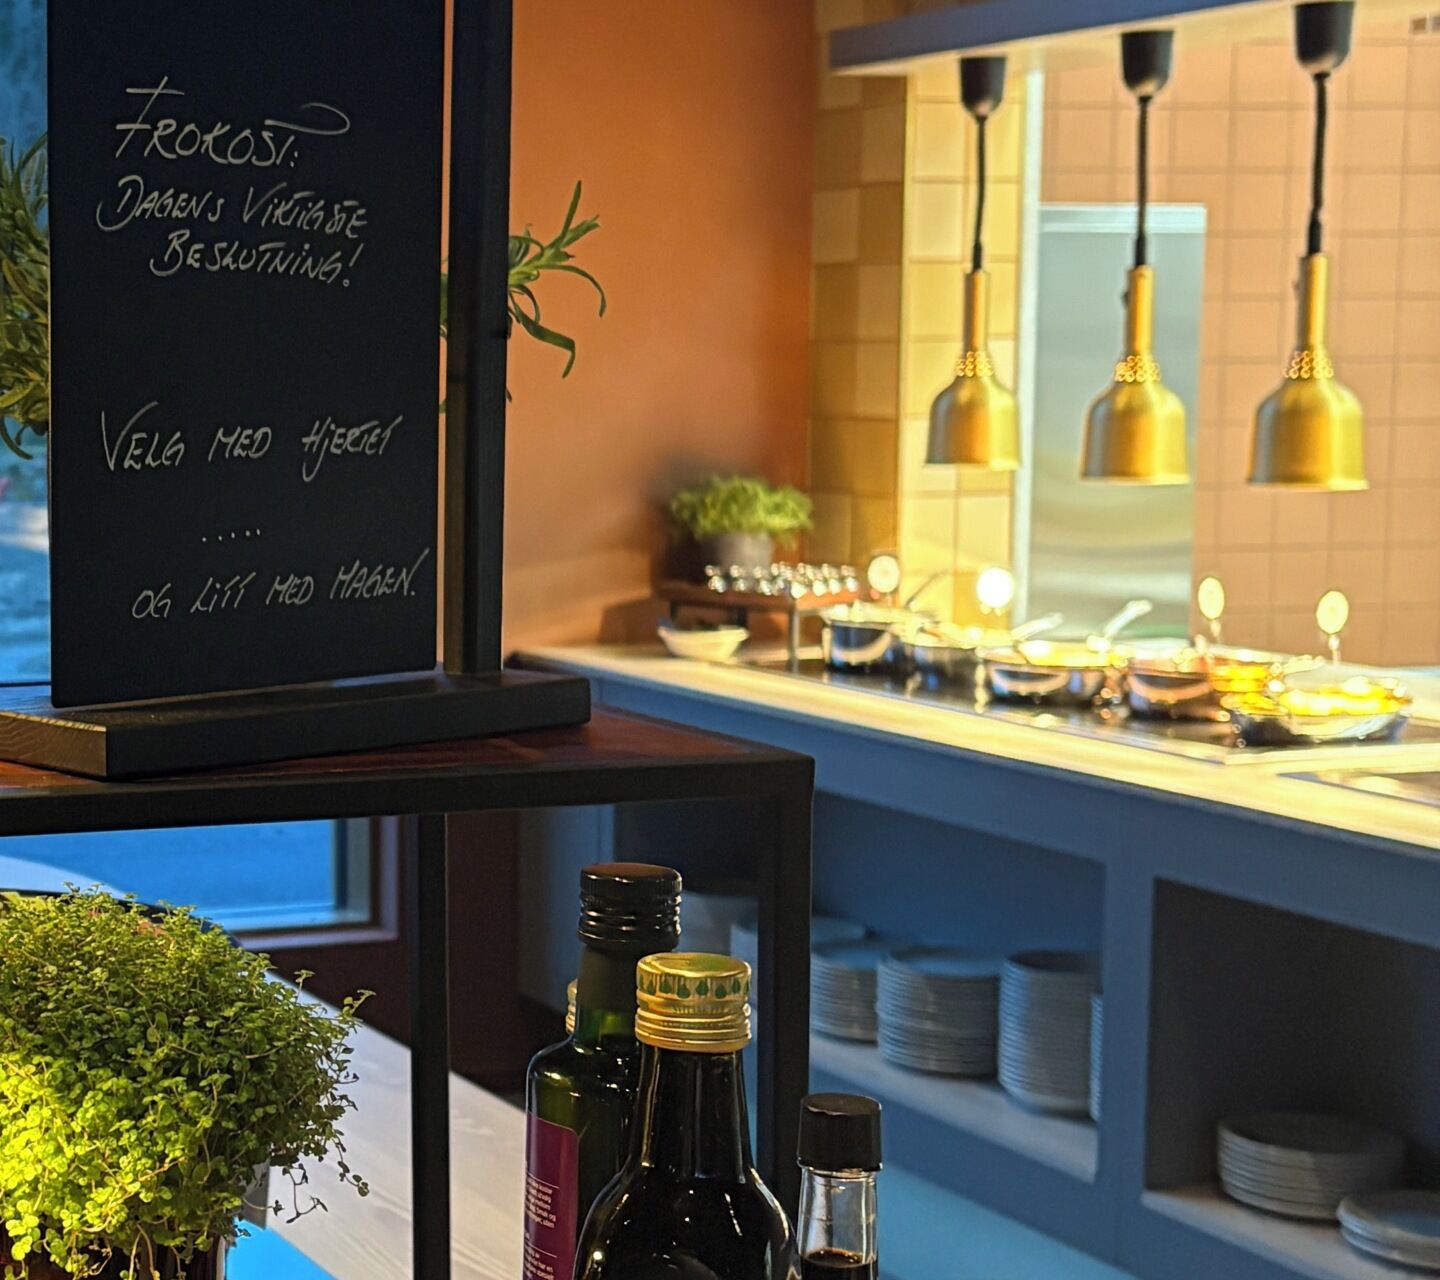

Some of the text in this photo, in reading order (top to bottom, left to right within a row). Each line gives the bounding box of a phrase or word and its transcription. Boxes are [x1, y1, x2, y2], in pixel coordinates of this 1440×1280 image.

[101, 400, 186, 471] VELG
[207, 425, 272, 462] MED
[131, 582, 172, 619] OG
[265, 573, 315, 606] MED
